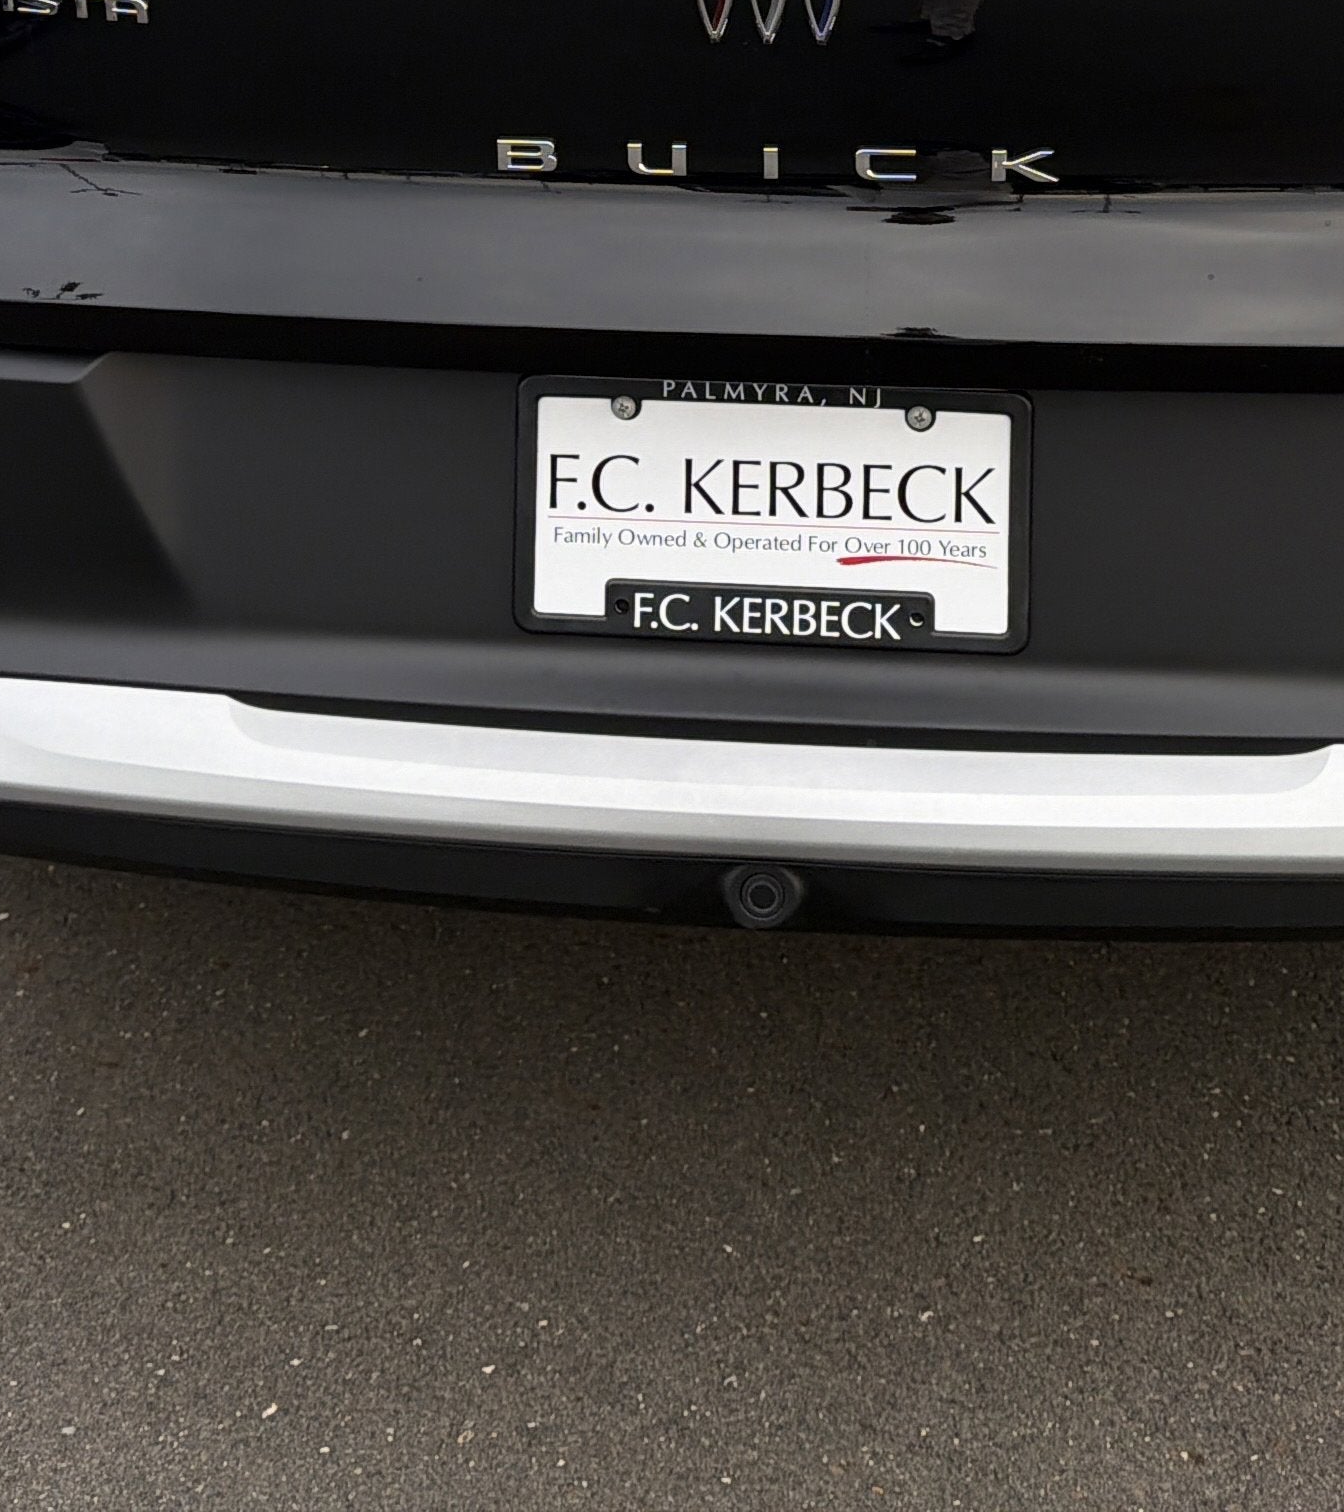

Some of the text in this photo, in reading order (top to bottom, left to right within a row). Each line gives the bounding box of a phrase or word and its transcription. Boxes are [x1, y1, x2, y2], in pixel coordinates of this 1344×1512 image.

[497, 138, 1059, 182] BUICK
[662, 380, 882, 408] PALMYRA, NJ
[549, 454, 996, 525] F.C. KERBECK
[554, 526, 987, 558] Family Owned & Operated For Over 100 Years
[633, 592, 902, 640] F.C. KERBECK
